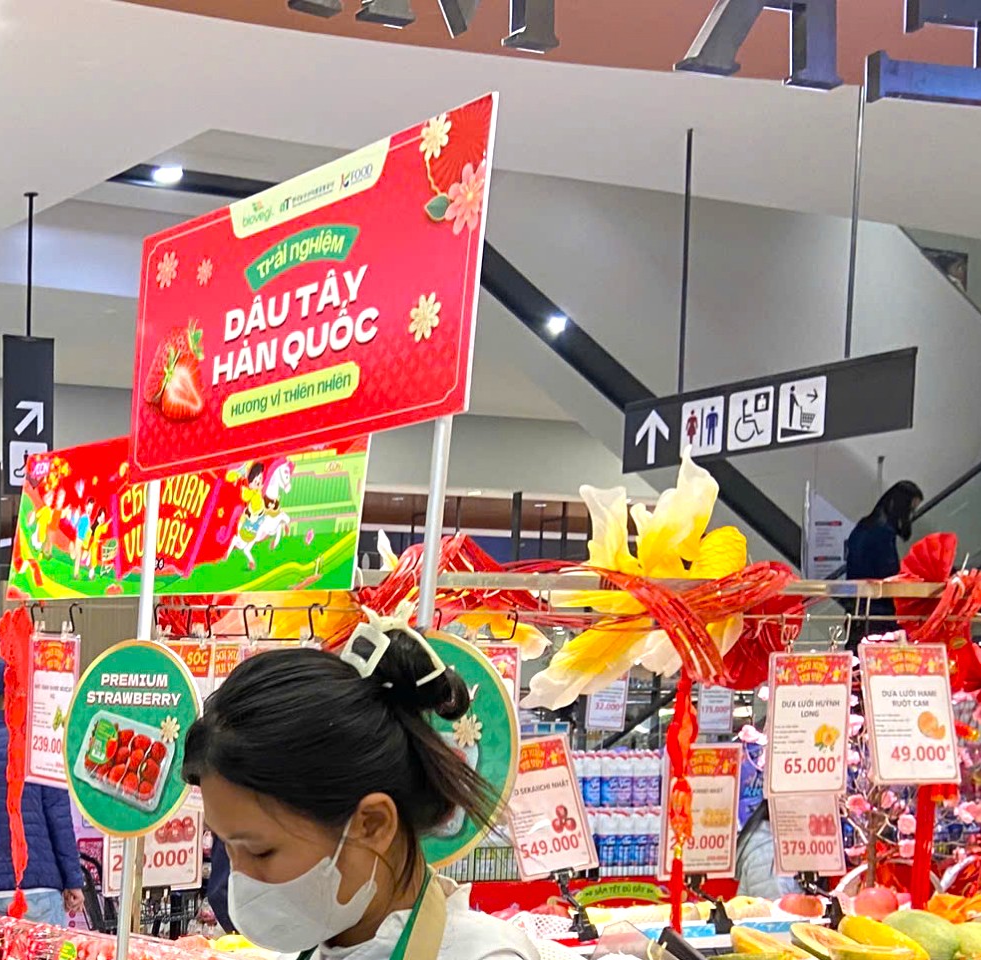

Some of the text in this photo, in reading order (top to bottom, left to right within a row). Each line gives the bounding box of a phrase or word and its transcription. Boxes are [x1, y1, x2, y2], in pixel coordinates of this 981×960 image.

[224, 265, 369, 343] DÂU TÂY
[212, 301, 380, 387] HÀN QUỐC
[124, 522, 146, 563] VU
[101, 674, 168, 688] PREMIUM
[86, 691, 181, 707] STRAWBERRY
[32, 734, 62, 751] 239.00
[670, 834, 730, 850] 29.000đ
